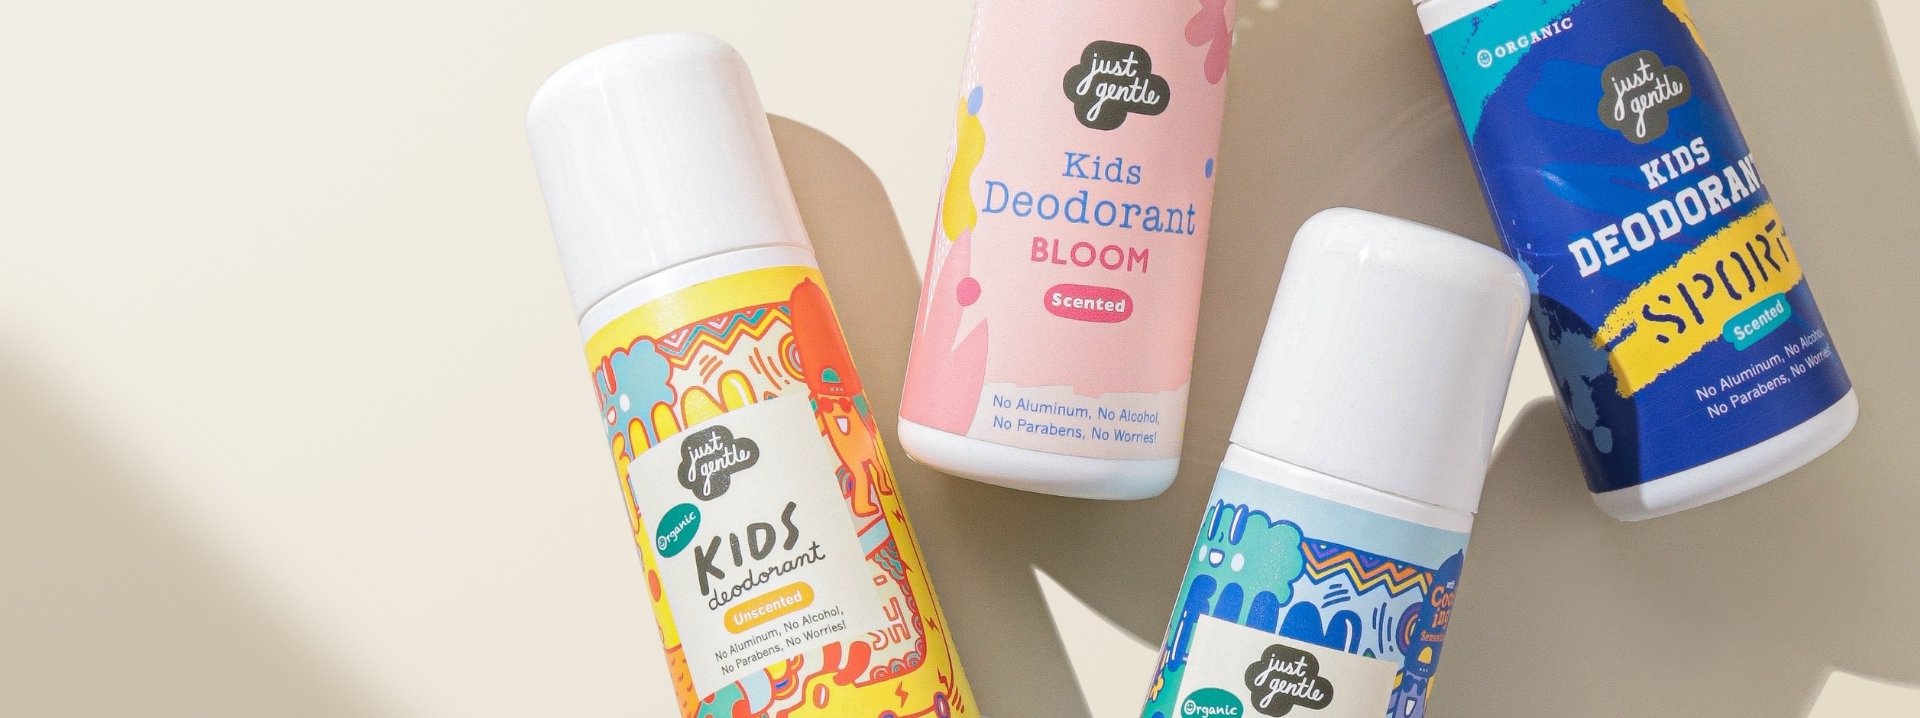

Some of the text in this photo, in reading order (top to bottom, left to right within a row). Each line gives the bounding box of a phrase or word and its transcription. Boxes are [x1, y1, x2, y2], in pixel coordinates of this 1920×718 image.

[1494, 17, 1573, 58] ORGANIC
[1076, 51, 1139, 96] just
[1611, 58, 1654, 121] just
[1086, 78, 1160, 122] gentle
[1630, 74, 1683, 138] gentle
[1062, 151, 1142, 185] Kids
[1639, 137, 1711, 190] KIDS
[981, 180, 1196, 236] Deodorant
[1031, 236, 1150, 273] BLOOM
[1051, 293, 1126, 313] Scented
[1642, 219, 1790, 344] SPORT
[1733, 299, 1785, 341] Scented
[1696, 386, 1717, 402] No
[1719, 354, 1785, 392] Aluminum,
[1784, 344, 1800, 358] No
[1707, 403, 1728, 419] No
[1730, 373, 1791, 409] Parabens,
[1789, 363, 1806, 378] No
[992, 395, 1160, 425] No Aluminum, No Alcohol,
[993, 415, 1157, 444] No Parabens, No Worries!
[687, 431, 724, 482] just
[700, 444, 750, 496] gentle
[657, 511, 697, 551] Organic
[694, 501, 800, 596] KIDS
[708, 541, 826, 611] deodorant
[732, 590, 803, 627] Unscented
[714, 605, 844, 662] No Aluminum, No Alcohol,
[721, 619, 847, 676] No Parabens, No Worries!
[1254, 653, 1308, 687] just
[1259, 675, 1325, 709] gentle
[1184, 699, 1238, 718] Organic
